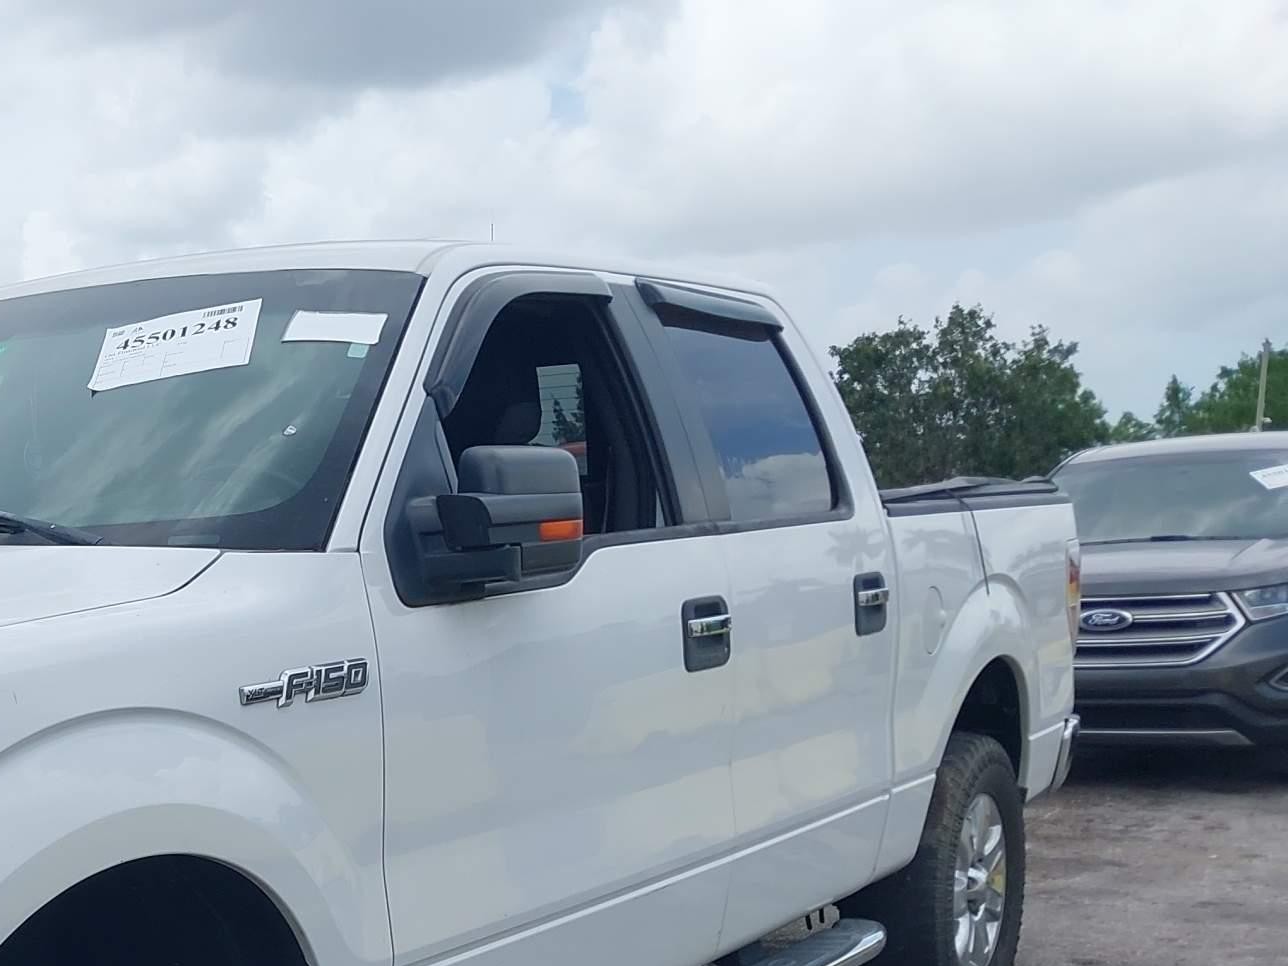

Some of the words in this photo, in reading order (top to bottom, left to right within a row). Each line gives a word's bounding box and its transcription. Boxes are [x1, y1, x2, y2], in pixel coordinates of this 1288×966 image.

[116, 316, 238, 351] 45501248
[1088, 613, 1120, 625] Ford
[277, 658, 370, 708] F-150
